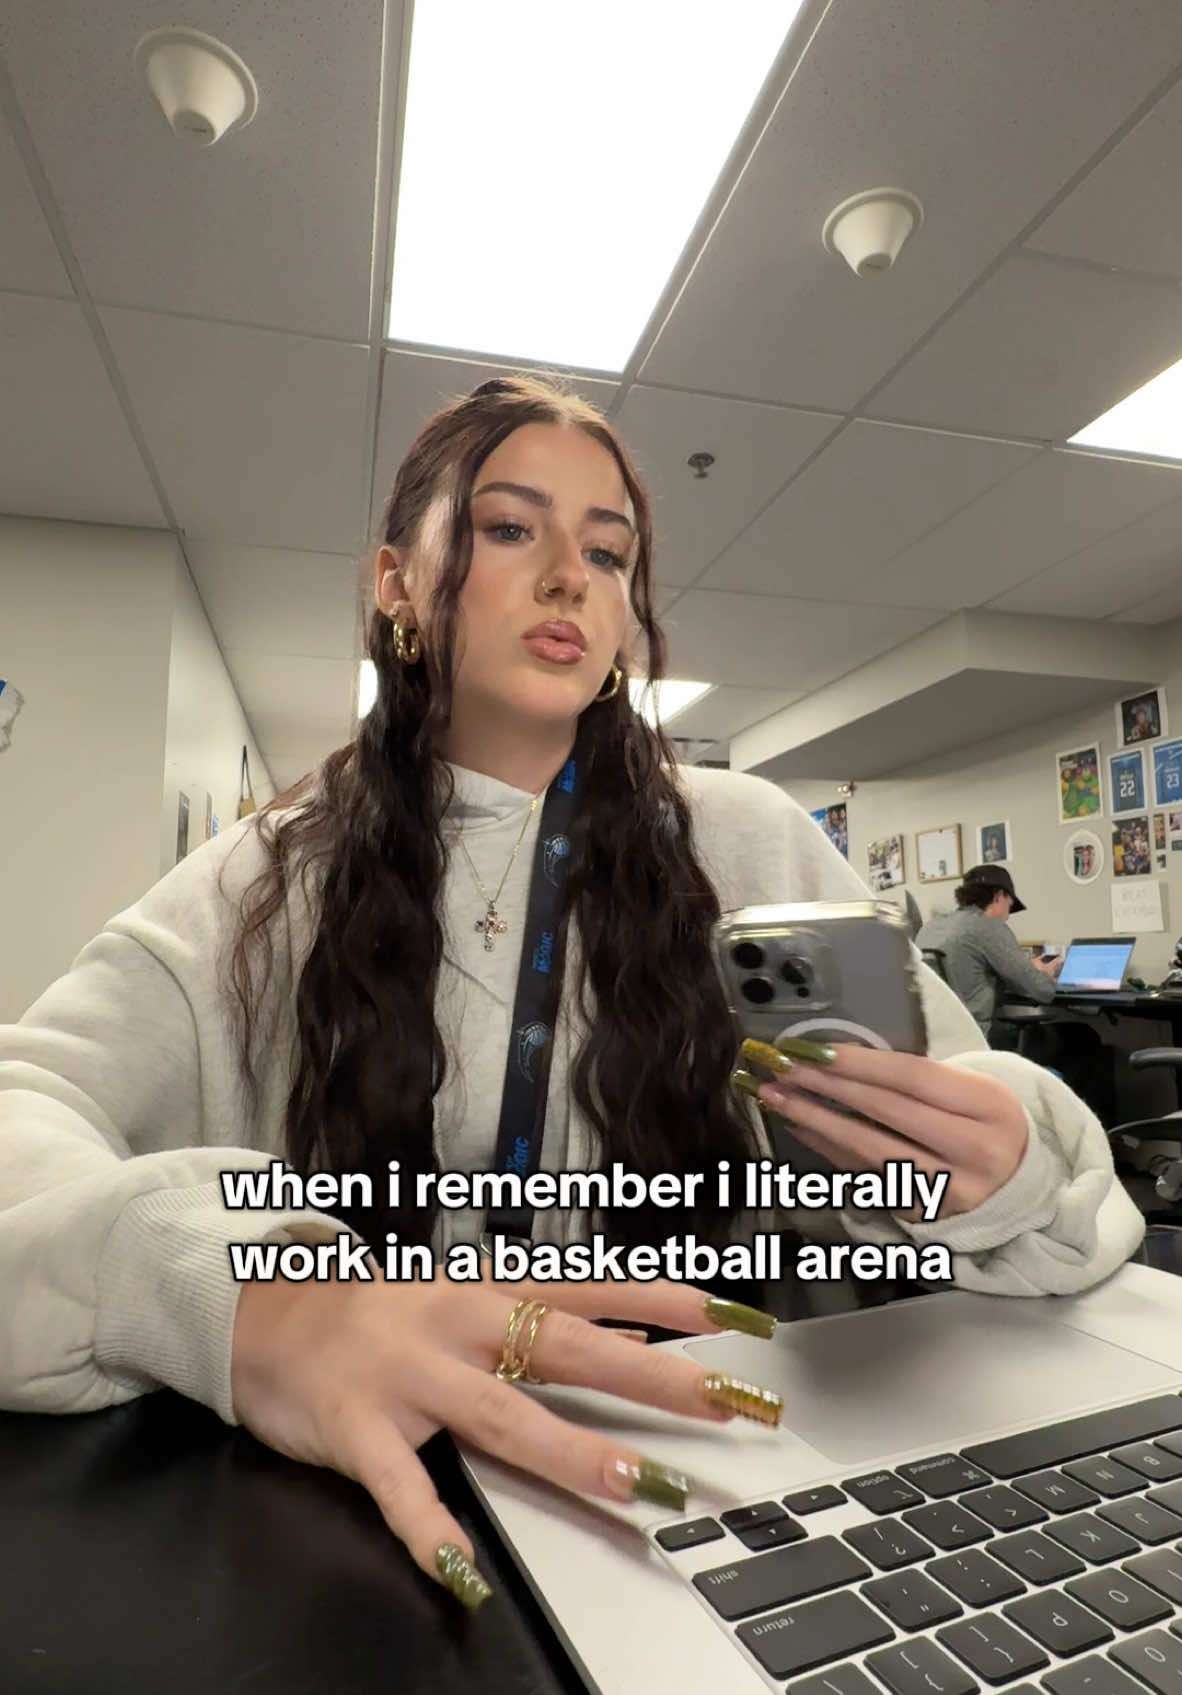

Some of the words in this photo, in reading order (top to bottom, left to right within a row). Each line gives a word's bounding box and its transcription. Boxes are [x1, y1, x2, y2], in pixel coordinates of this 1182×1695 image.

[1120, 780, 1136, 798] 22
[1143, 1455, 1161, 1466] B
[1135, 1512, 1150, 1525] J
[1079, 1529, 1101, 1543] K
[1024, 1548, 1045, 1560] L
[707, 1569, 739, 1585] shift
[752, 1616, 795, 1636] return
[1052, 1611, 1069, 1627] P
